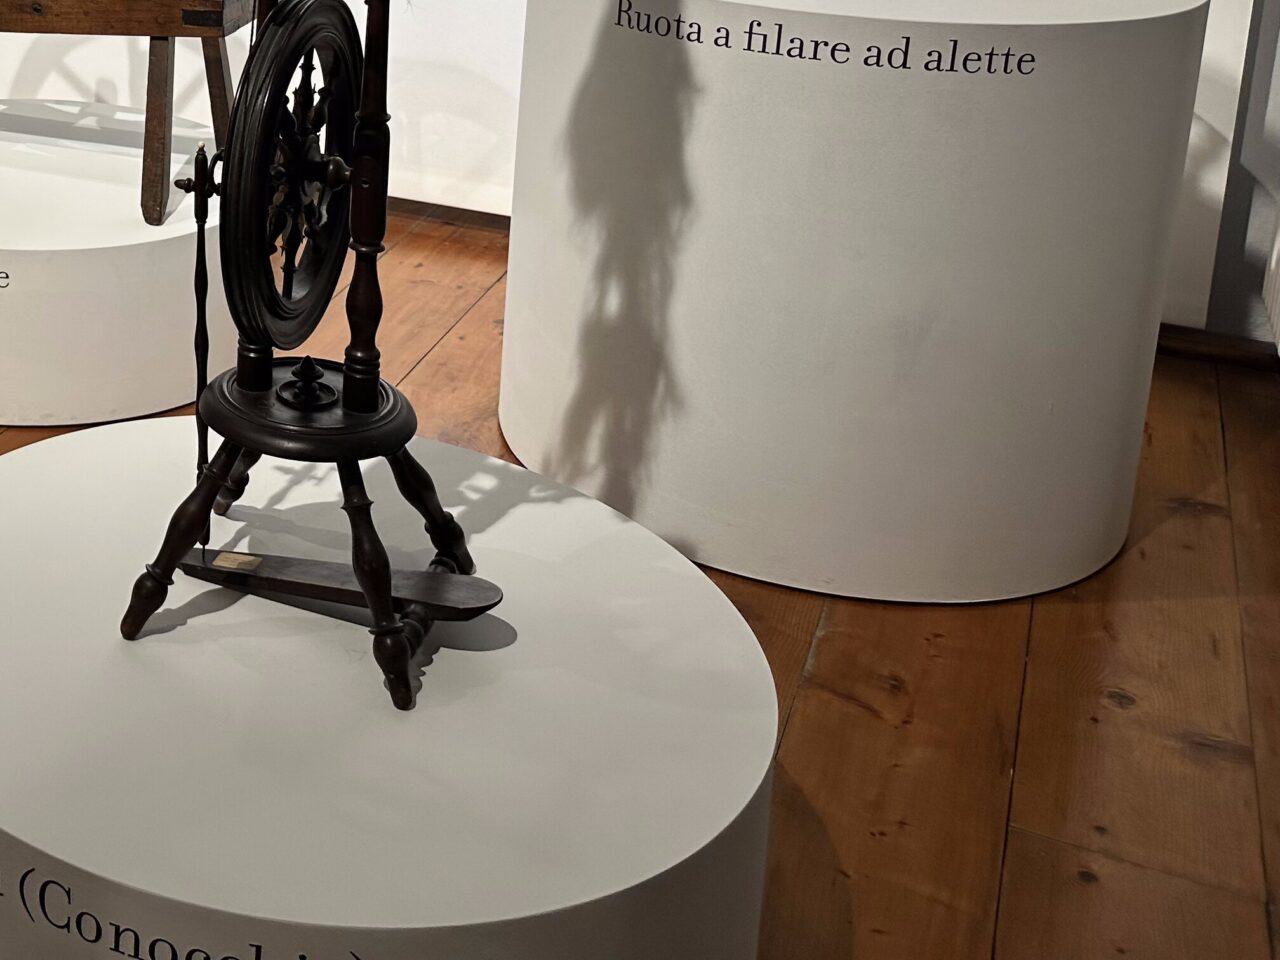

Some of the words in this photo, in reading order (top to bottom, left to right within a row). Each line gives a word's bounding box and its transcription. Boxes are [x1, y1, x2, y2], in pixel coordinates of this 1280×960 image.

[713, 27, 732, 49] a
[743, 19, 851, 64] filare
[863, 36, 911, 70] ad
[923, 39, 1037, 76] alette
